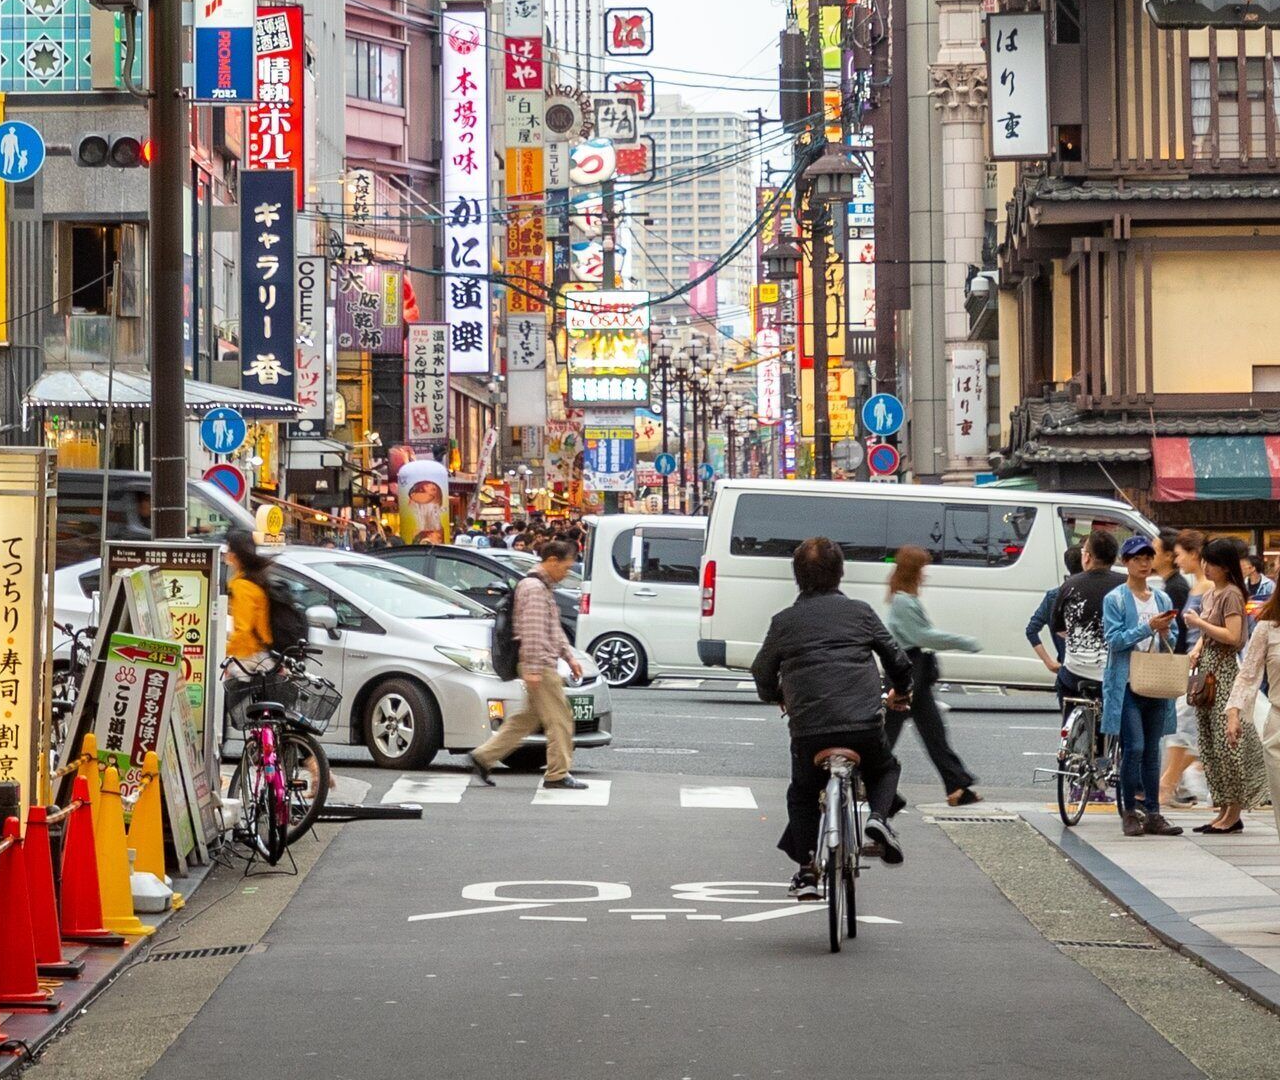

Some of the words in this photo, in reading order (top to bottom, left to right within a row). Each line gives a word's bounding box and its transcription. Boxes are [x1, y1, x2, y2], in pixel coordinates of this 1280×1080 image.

[217, 31, 232, 88] PROMISE
[996, 29, 1023, 139] はり重
[451, 66, 479, 176] 本場の味
[518, 97, 541, 144] 白木屋
[601, 106, 634, 133] 牛角
[253, 201, 282, 341] ギャラリー
[243, 353, 293, 387] 香
[956, 376, 973, 436] はり重
[147, 651, 166, 663] 4F
[137, 672, 165, 767] 全身もみほぐし
